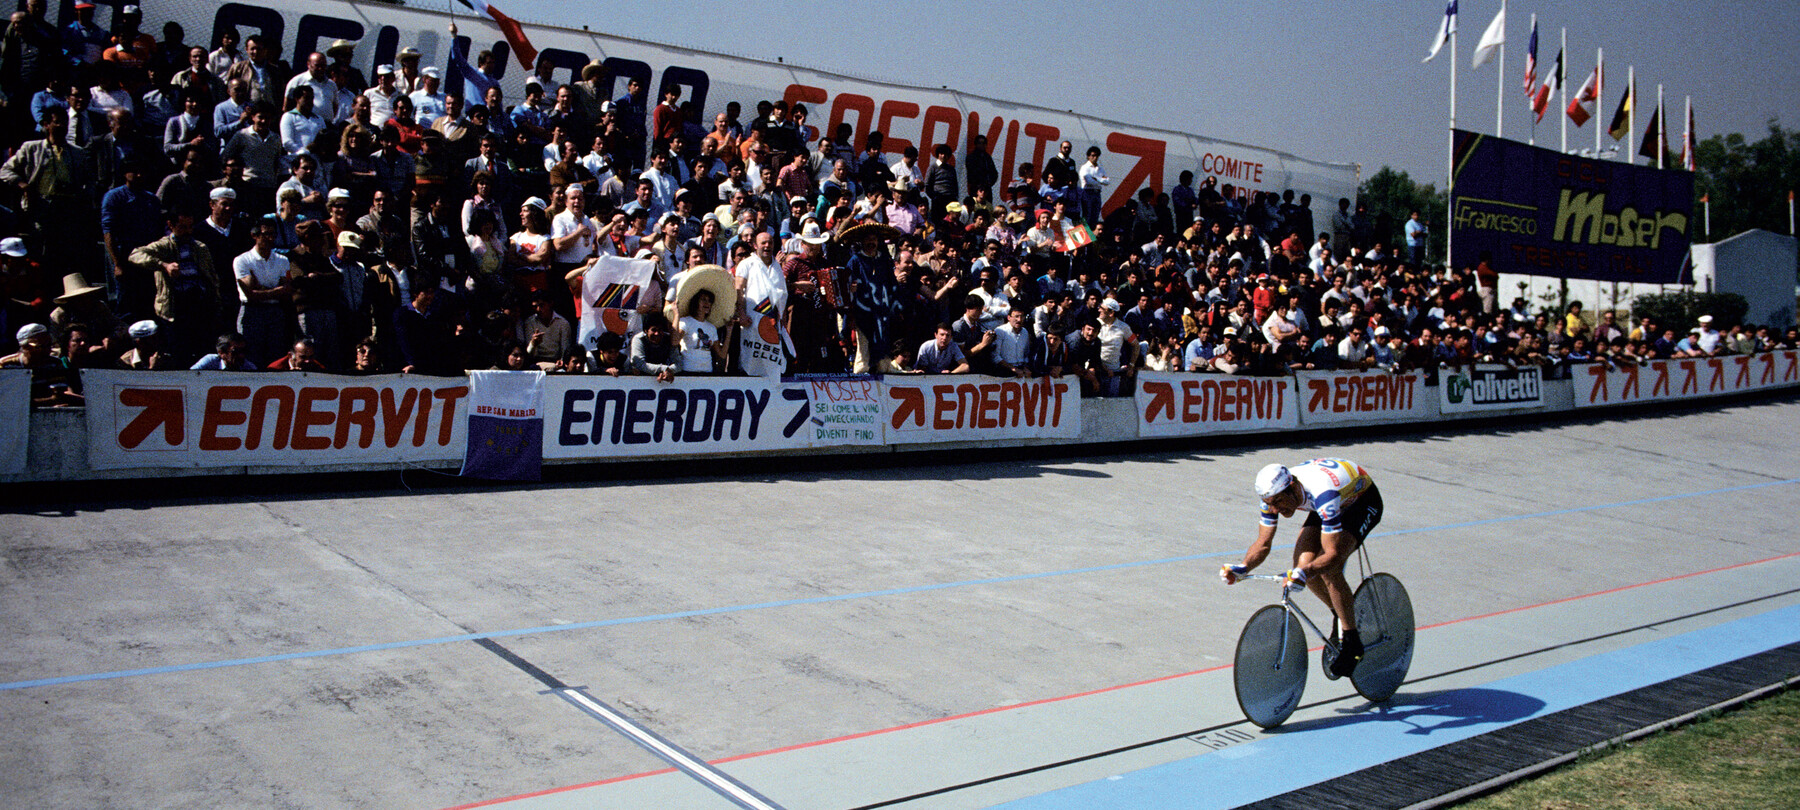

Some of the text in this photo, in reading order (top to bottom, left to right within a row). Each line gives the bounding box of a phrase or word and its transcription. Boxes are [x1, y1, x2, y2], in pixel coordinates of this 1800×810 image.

[1202, 153, 1264, 183] COMITE
[1512, 245, 1589, 270] TRENTO
[743, 339, 780, 355] MOSE
[811, 380, 877, 403] MOSER
[1332, 374, 1417, 413] ENERVIT
[1473, 371, 1538, 402] olivetti
[815, 403, 829, 414] SEI
[832, 404, 851, 413] COME
[863, 404, 879, 413] VINO
[933, 383, 1068, 430] ENERVIT
[1181, 379, 1287, 424] ENERVIT
[199, 385, 469, 451] ENERVIT
[558, 388, 770, 446] ENERDAY
[824, 414, 875, 424] INVECCHIANDO
[816, 428, 874, 440] DIVENTI FINO
[1195, 729, 1256, 748] 310
